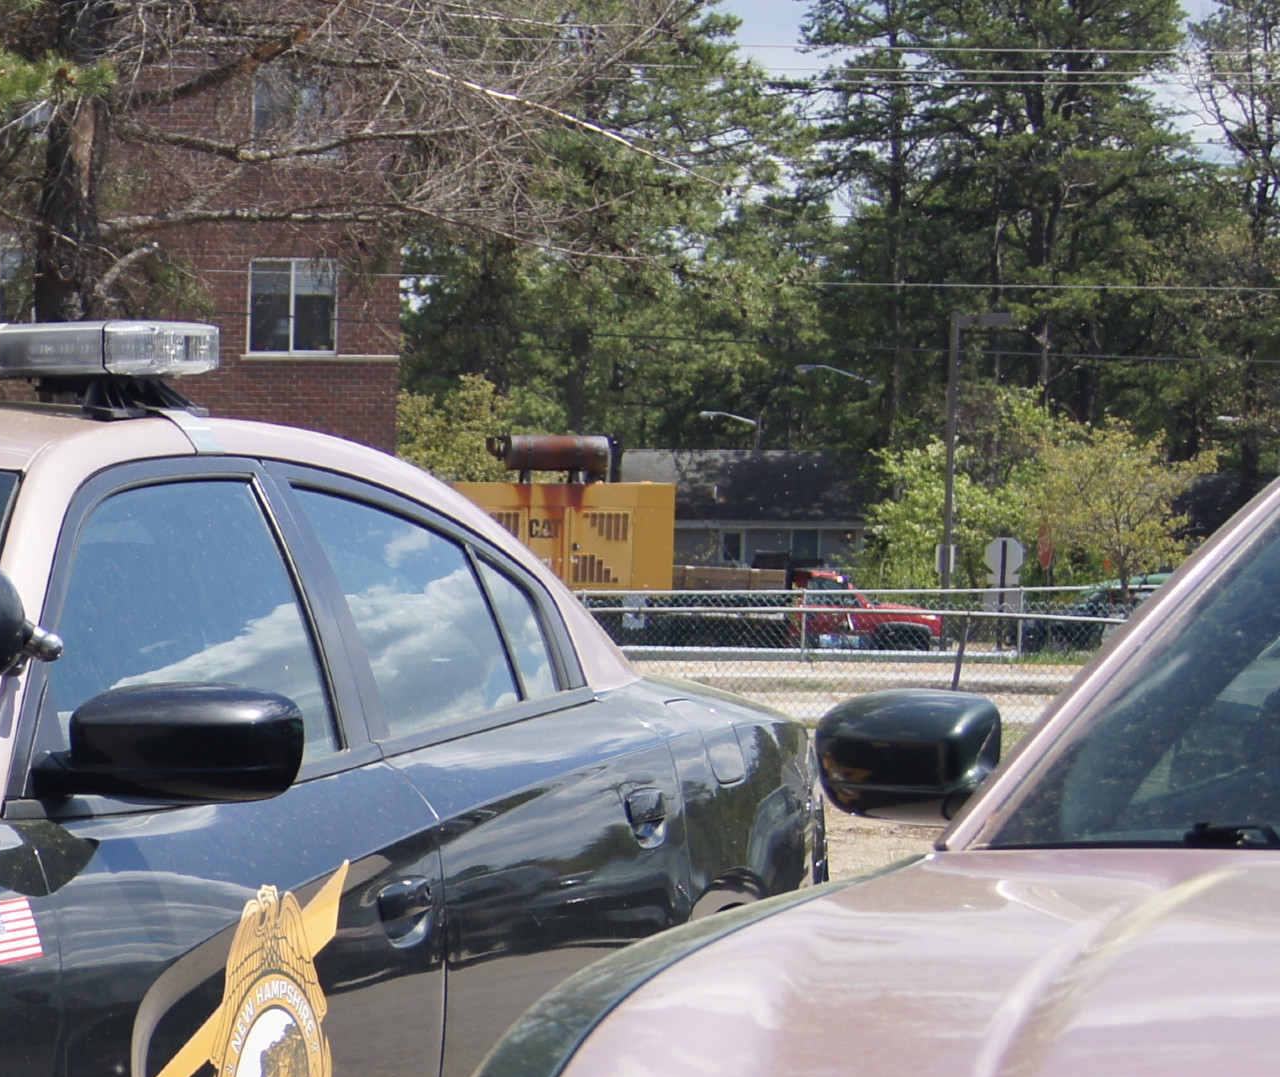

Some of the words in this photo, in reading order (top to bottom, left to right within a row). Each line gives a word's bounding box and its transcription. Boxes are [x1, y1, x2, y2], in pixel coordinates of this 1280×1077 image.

[529, 518, 563, 539] CAT
[231, 997, 255, 1055] NEW
[256, 980, 316, 1039] HAMPSHIRE
